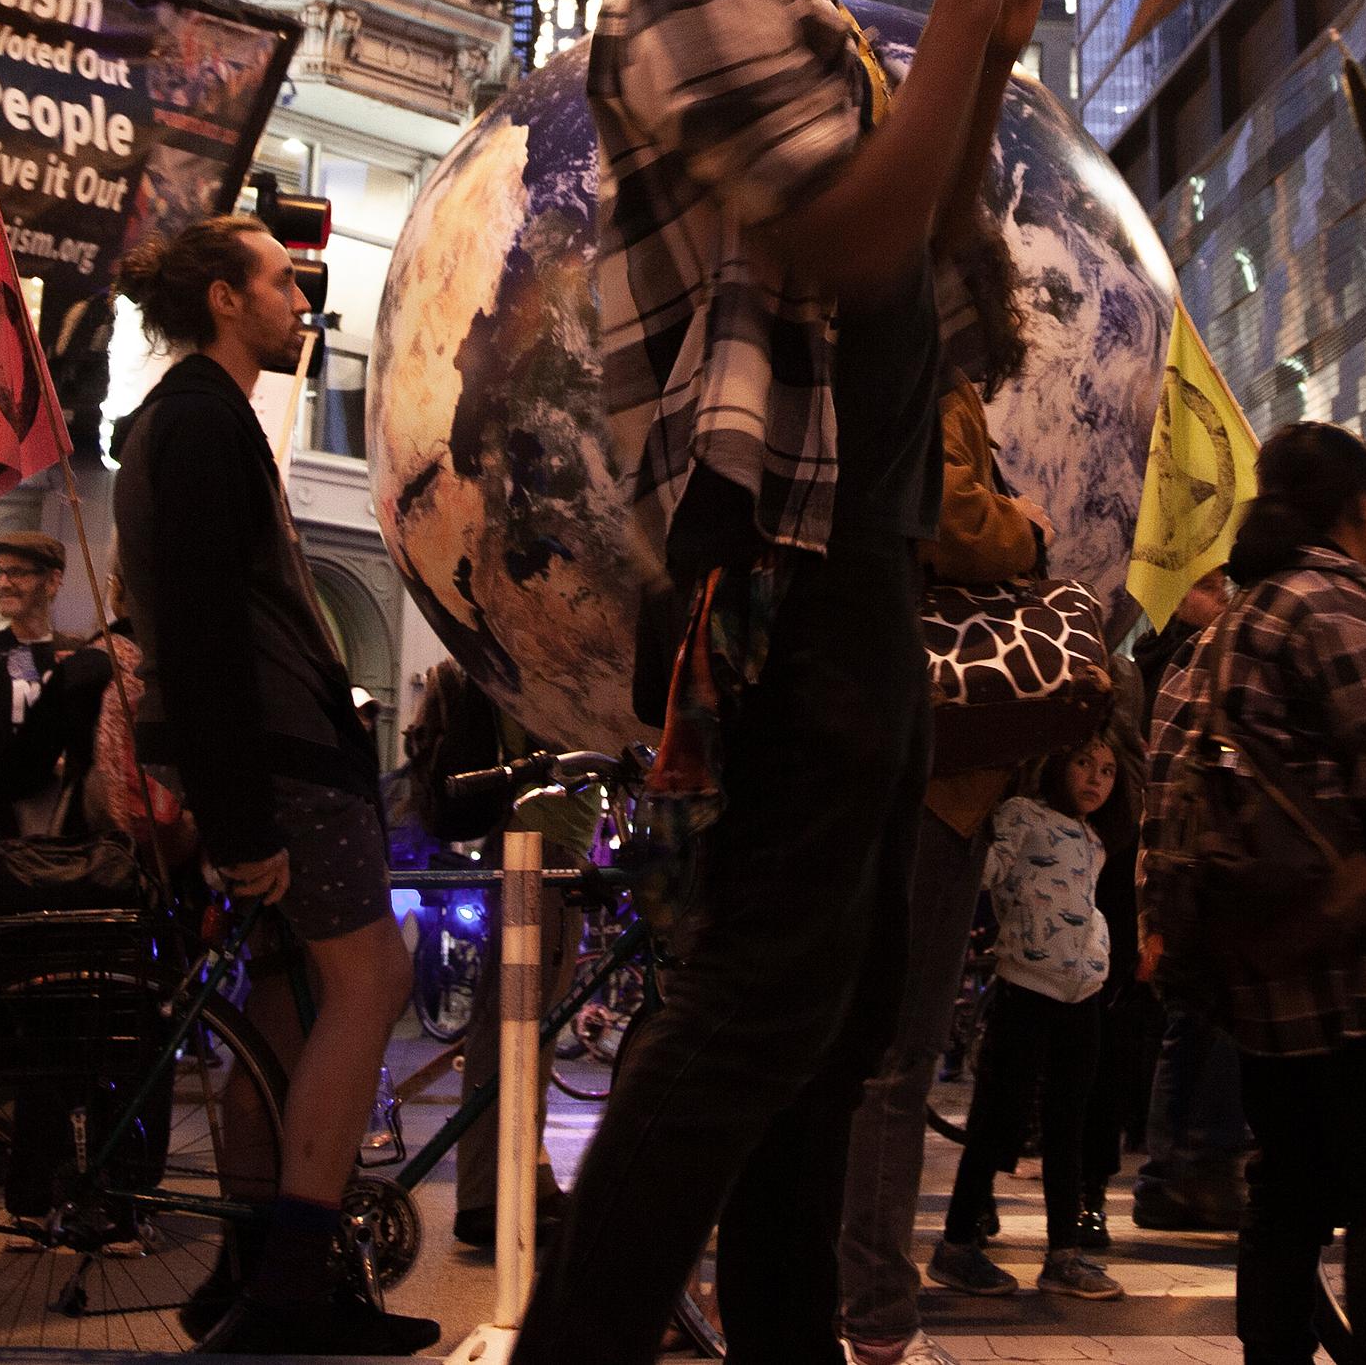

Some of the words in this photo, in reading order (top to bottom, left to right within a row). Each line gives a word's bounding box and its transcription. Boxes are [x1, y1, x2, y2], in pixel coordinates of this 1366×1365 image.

[76, 47, 133, 90] Out
[41, 152, 71, 200] it
[74, 166, 128, 213] Out
